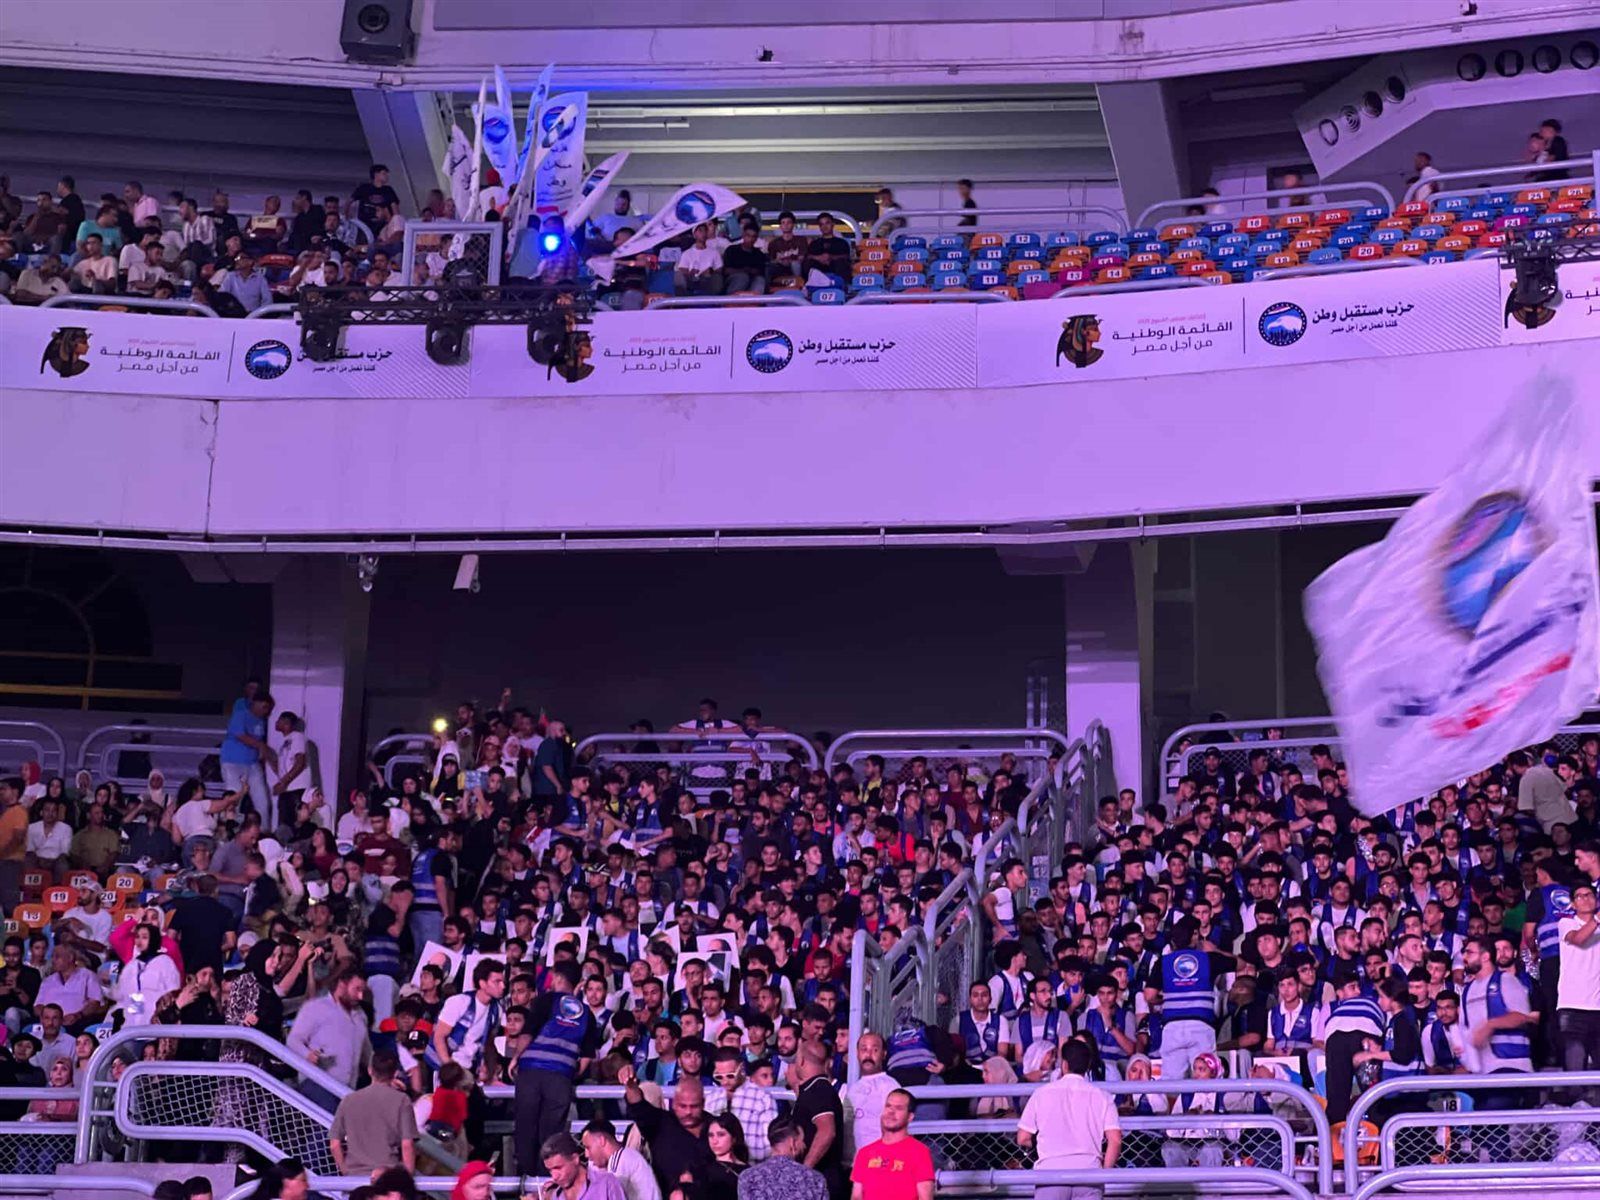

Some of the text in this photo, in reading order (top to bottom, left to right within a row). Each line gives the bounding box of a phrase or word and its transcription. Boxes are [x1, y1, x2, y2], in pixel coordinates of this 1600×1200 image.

[1312, 301, 1415, 324] حزب مستقبل وطن
[1112, 321, 1232, 341] القائمة الوطنية
[100, 346, 220, 361] القائمة الوطنية
[603, 345, 721, 359] القائمة الوطنية
[798, 338, 896, 354] حزب مستقبل وطن
[1131, 336, 1213, 356] من أجل مصر
[366, 348, 393, 361] حزب
[118, 361, 199, 376] من أجل مصر
[621, 358, 701, 374] من أجل مصر
[118, 878, 132, 887] 20
[101, 892, 114, 900] 20
